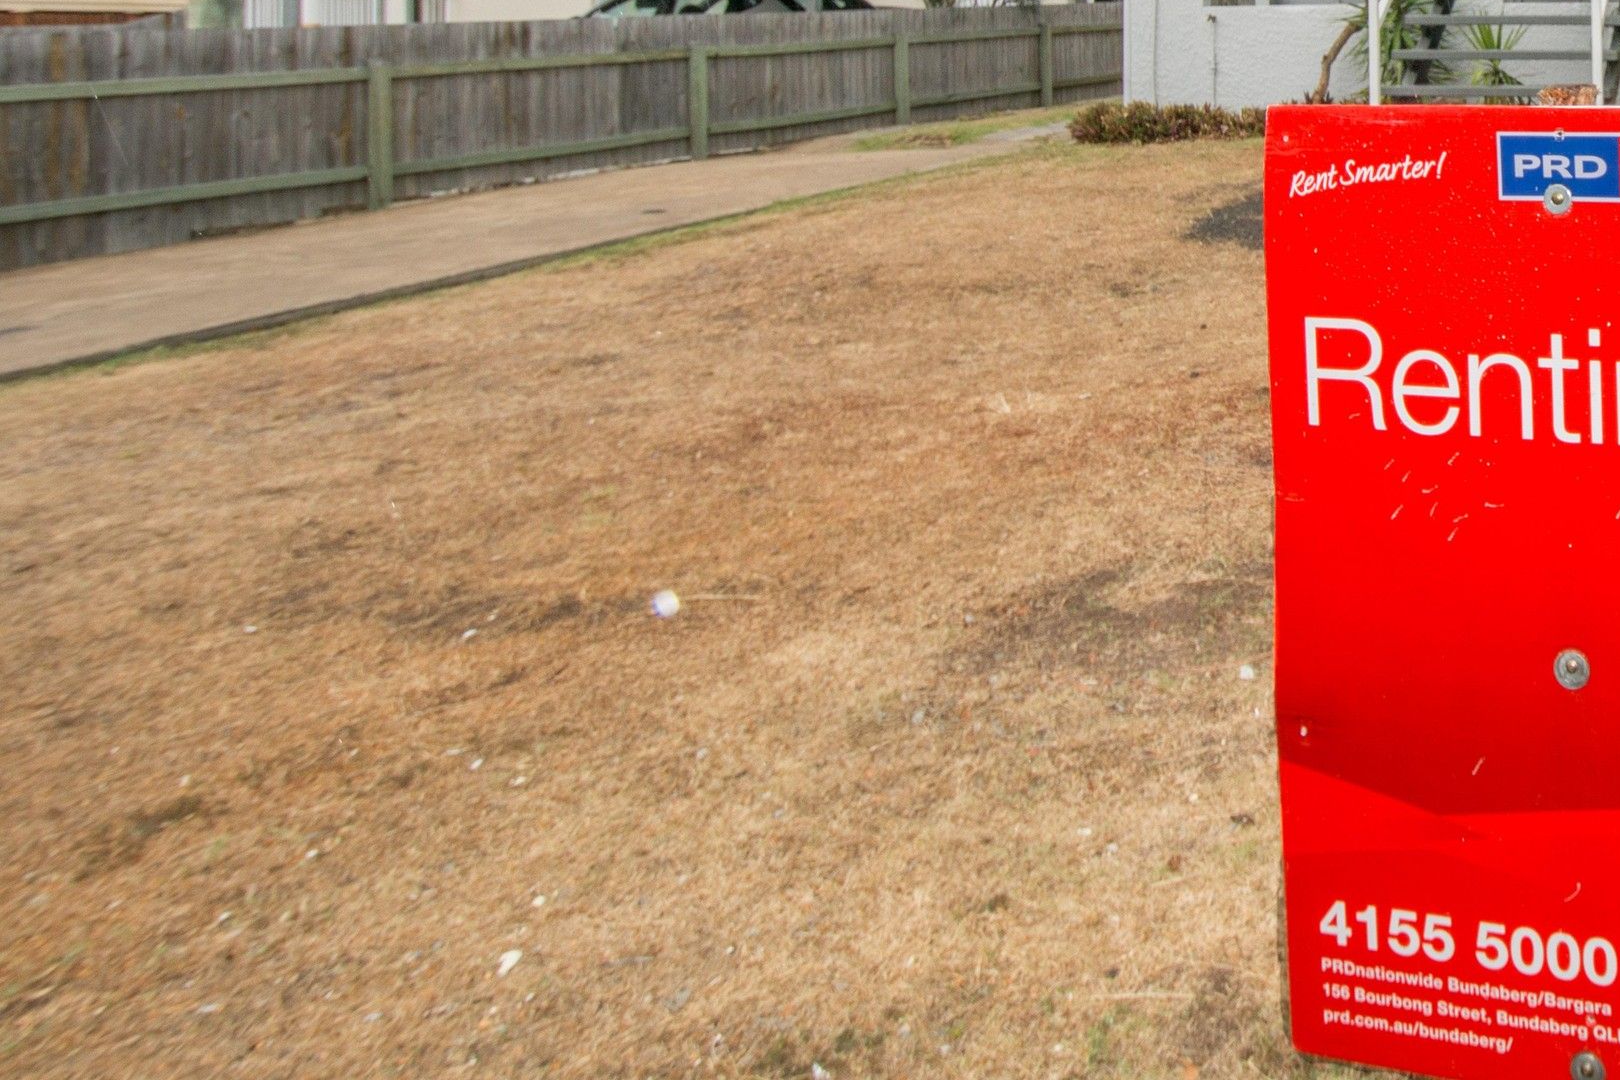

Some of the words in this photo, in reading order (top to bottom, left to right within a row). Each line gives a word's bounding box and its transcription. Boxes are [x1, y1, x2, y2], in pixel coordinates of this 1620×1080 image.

[1289, 167, 1338, 198] Rent
[1343, 151, 1447, 186] Smarter!
[1513, 153, 1609, 180] PRD
[1319, 900, 1455, 961] 4155
[1474, 921, 1619, 988] 5000
[1320, 956, 1444, 991] PRDnationwide
[1447, 977, 1612, 1017] Bundaberg/Bargara
[1322, 982, 1351, 1001] 156
[1354, 988, 1433, 1016] Bourbong
[1436, 1001, 1493, 1026] Street,
[1495, 1009, 1589, 1042] Bundaberg
[1322, 1008, 1515, 1054] prd.com.au/bundaberg/
